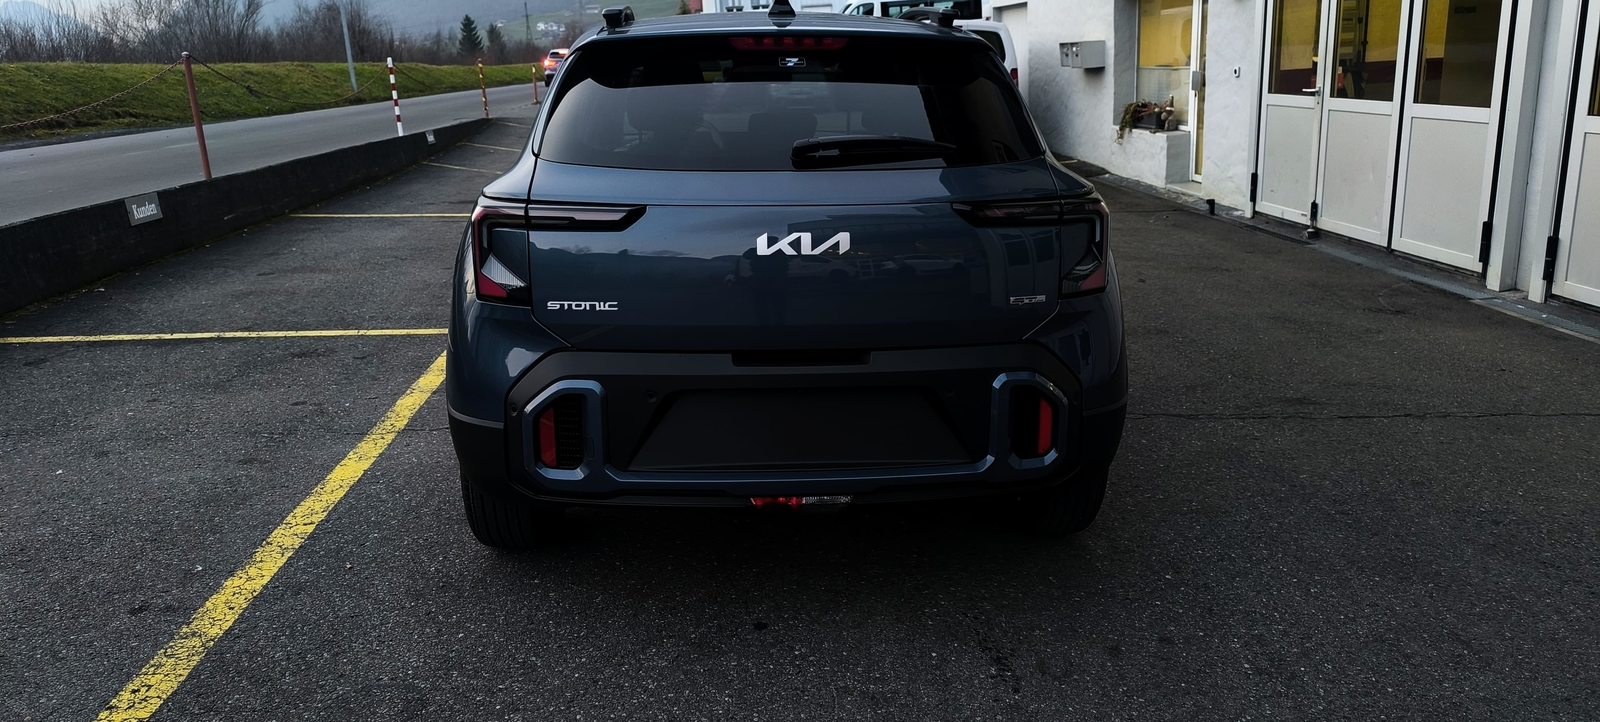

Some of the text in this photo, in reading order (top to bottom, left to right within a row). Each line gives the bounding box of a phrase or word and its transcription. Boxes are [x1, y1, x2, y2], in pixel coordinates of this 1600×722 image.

[131, 201, 158, 220] Kunden
[756, 231, 850, 256] KIA
[546, 301, 619, 311] STONIC
